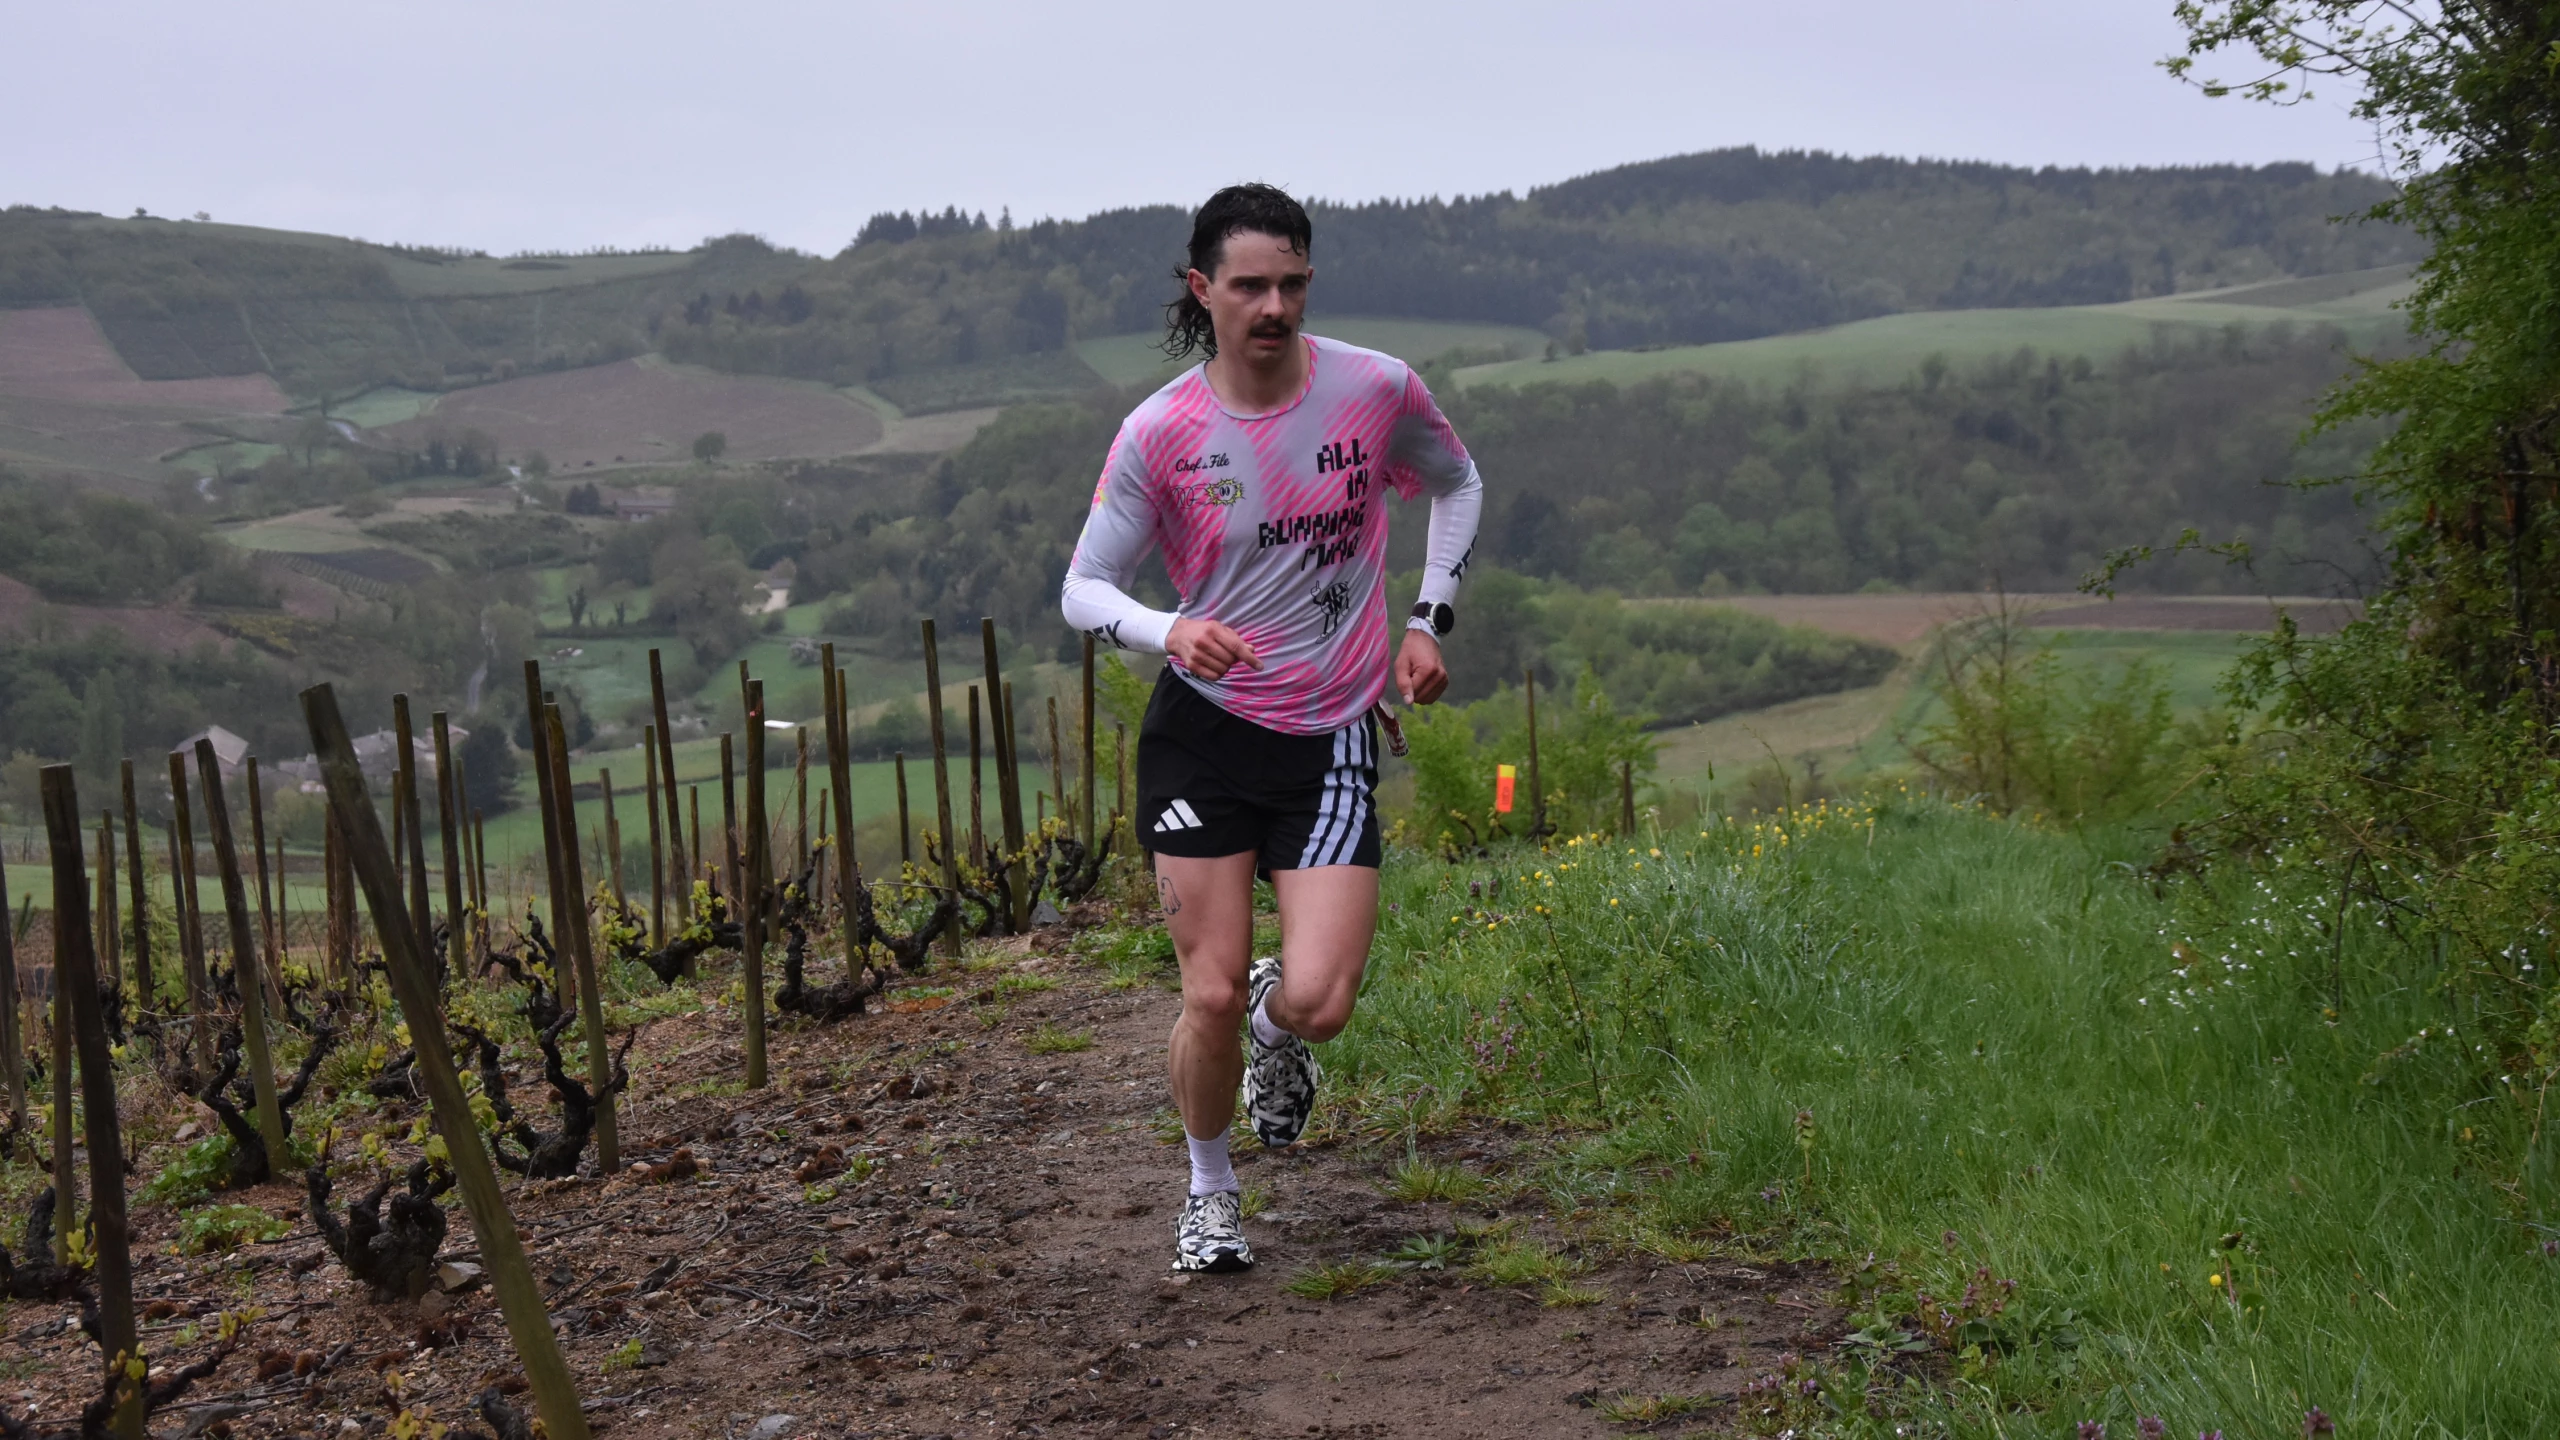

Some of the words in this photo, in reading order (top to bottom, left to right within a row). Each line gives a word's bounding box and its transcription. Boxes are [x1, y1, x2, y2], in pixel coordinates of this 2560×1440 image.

[1175, 457, 1202, 474] Chef
[1209, 453, 1231, 469] File
[1317, 438, 1368, 473] ALL
[1346, 468, 1368, 500] IN
[1258, 501, 1366, 548] RUNNING
